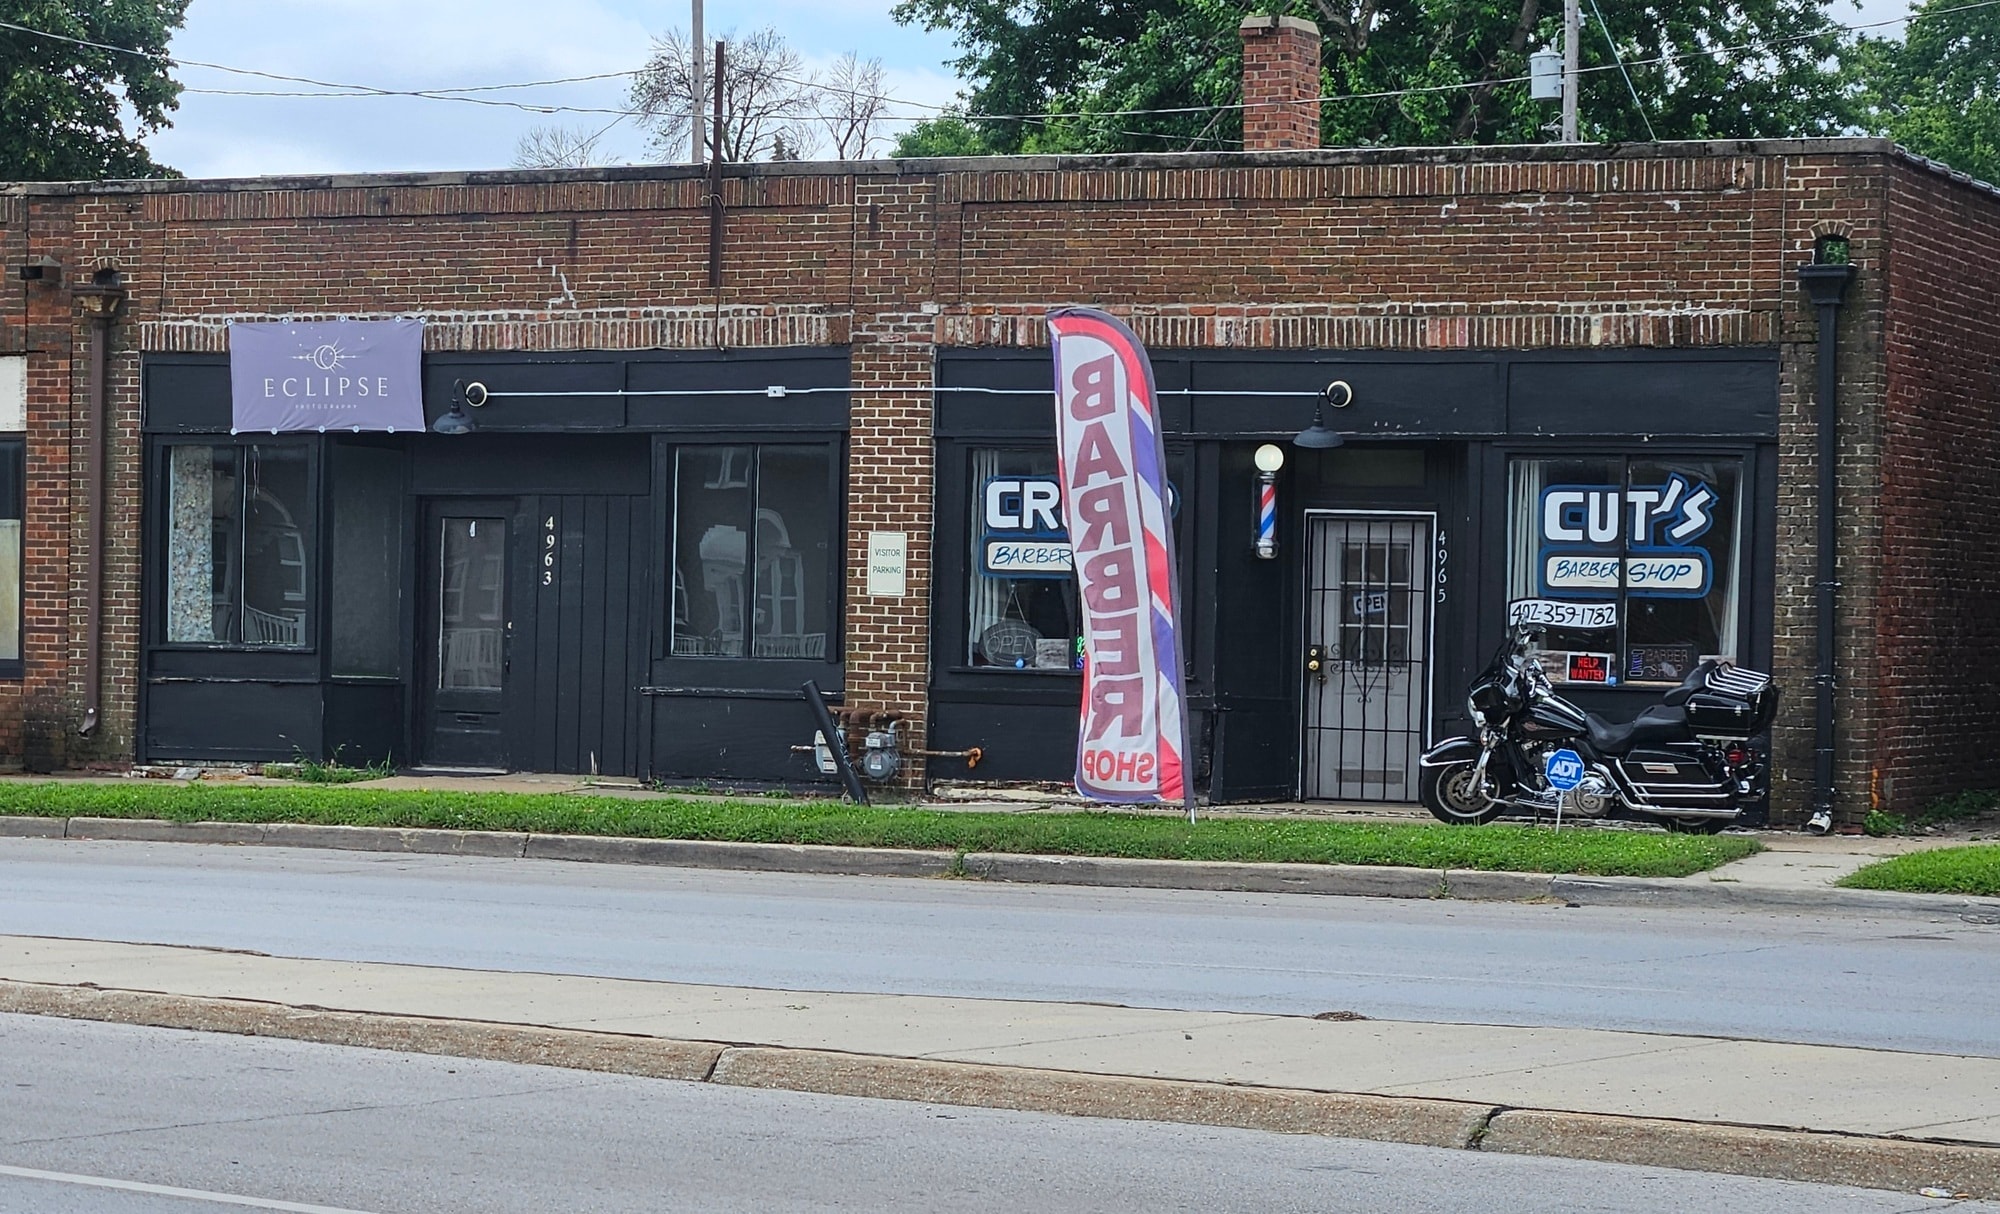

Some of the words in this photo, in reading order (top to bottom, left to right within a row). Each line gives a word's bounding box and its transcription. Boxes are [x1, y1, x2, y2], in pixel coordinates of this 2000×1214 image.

[264, 377, 388, 398] ECLIPSE
[1544, 478, 1711, 543] CUT'S
[542, 515, 555, 586] 4963
[874, 548, 901, 557] VISITOR
[992, 545, 1073, 565] BARBER
[872, 565, 902, 574] PARKING
[1437, 530, 1448, 603] 4965
[1553, 559, 1620, 581] BARBER
[1628, 562, 1692, 582] SHOP
[1577, 656, 1599, 668] HELP
[1570, 669, 1605, 680] WANTED
[1550, 760, 1581, 778] ADT
